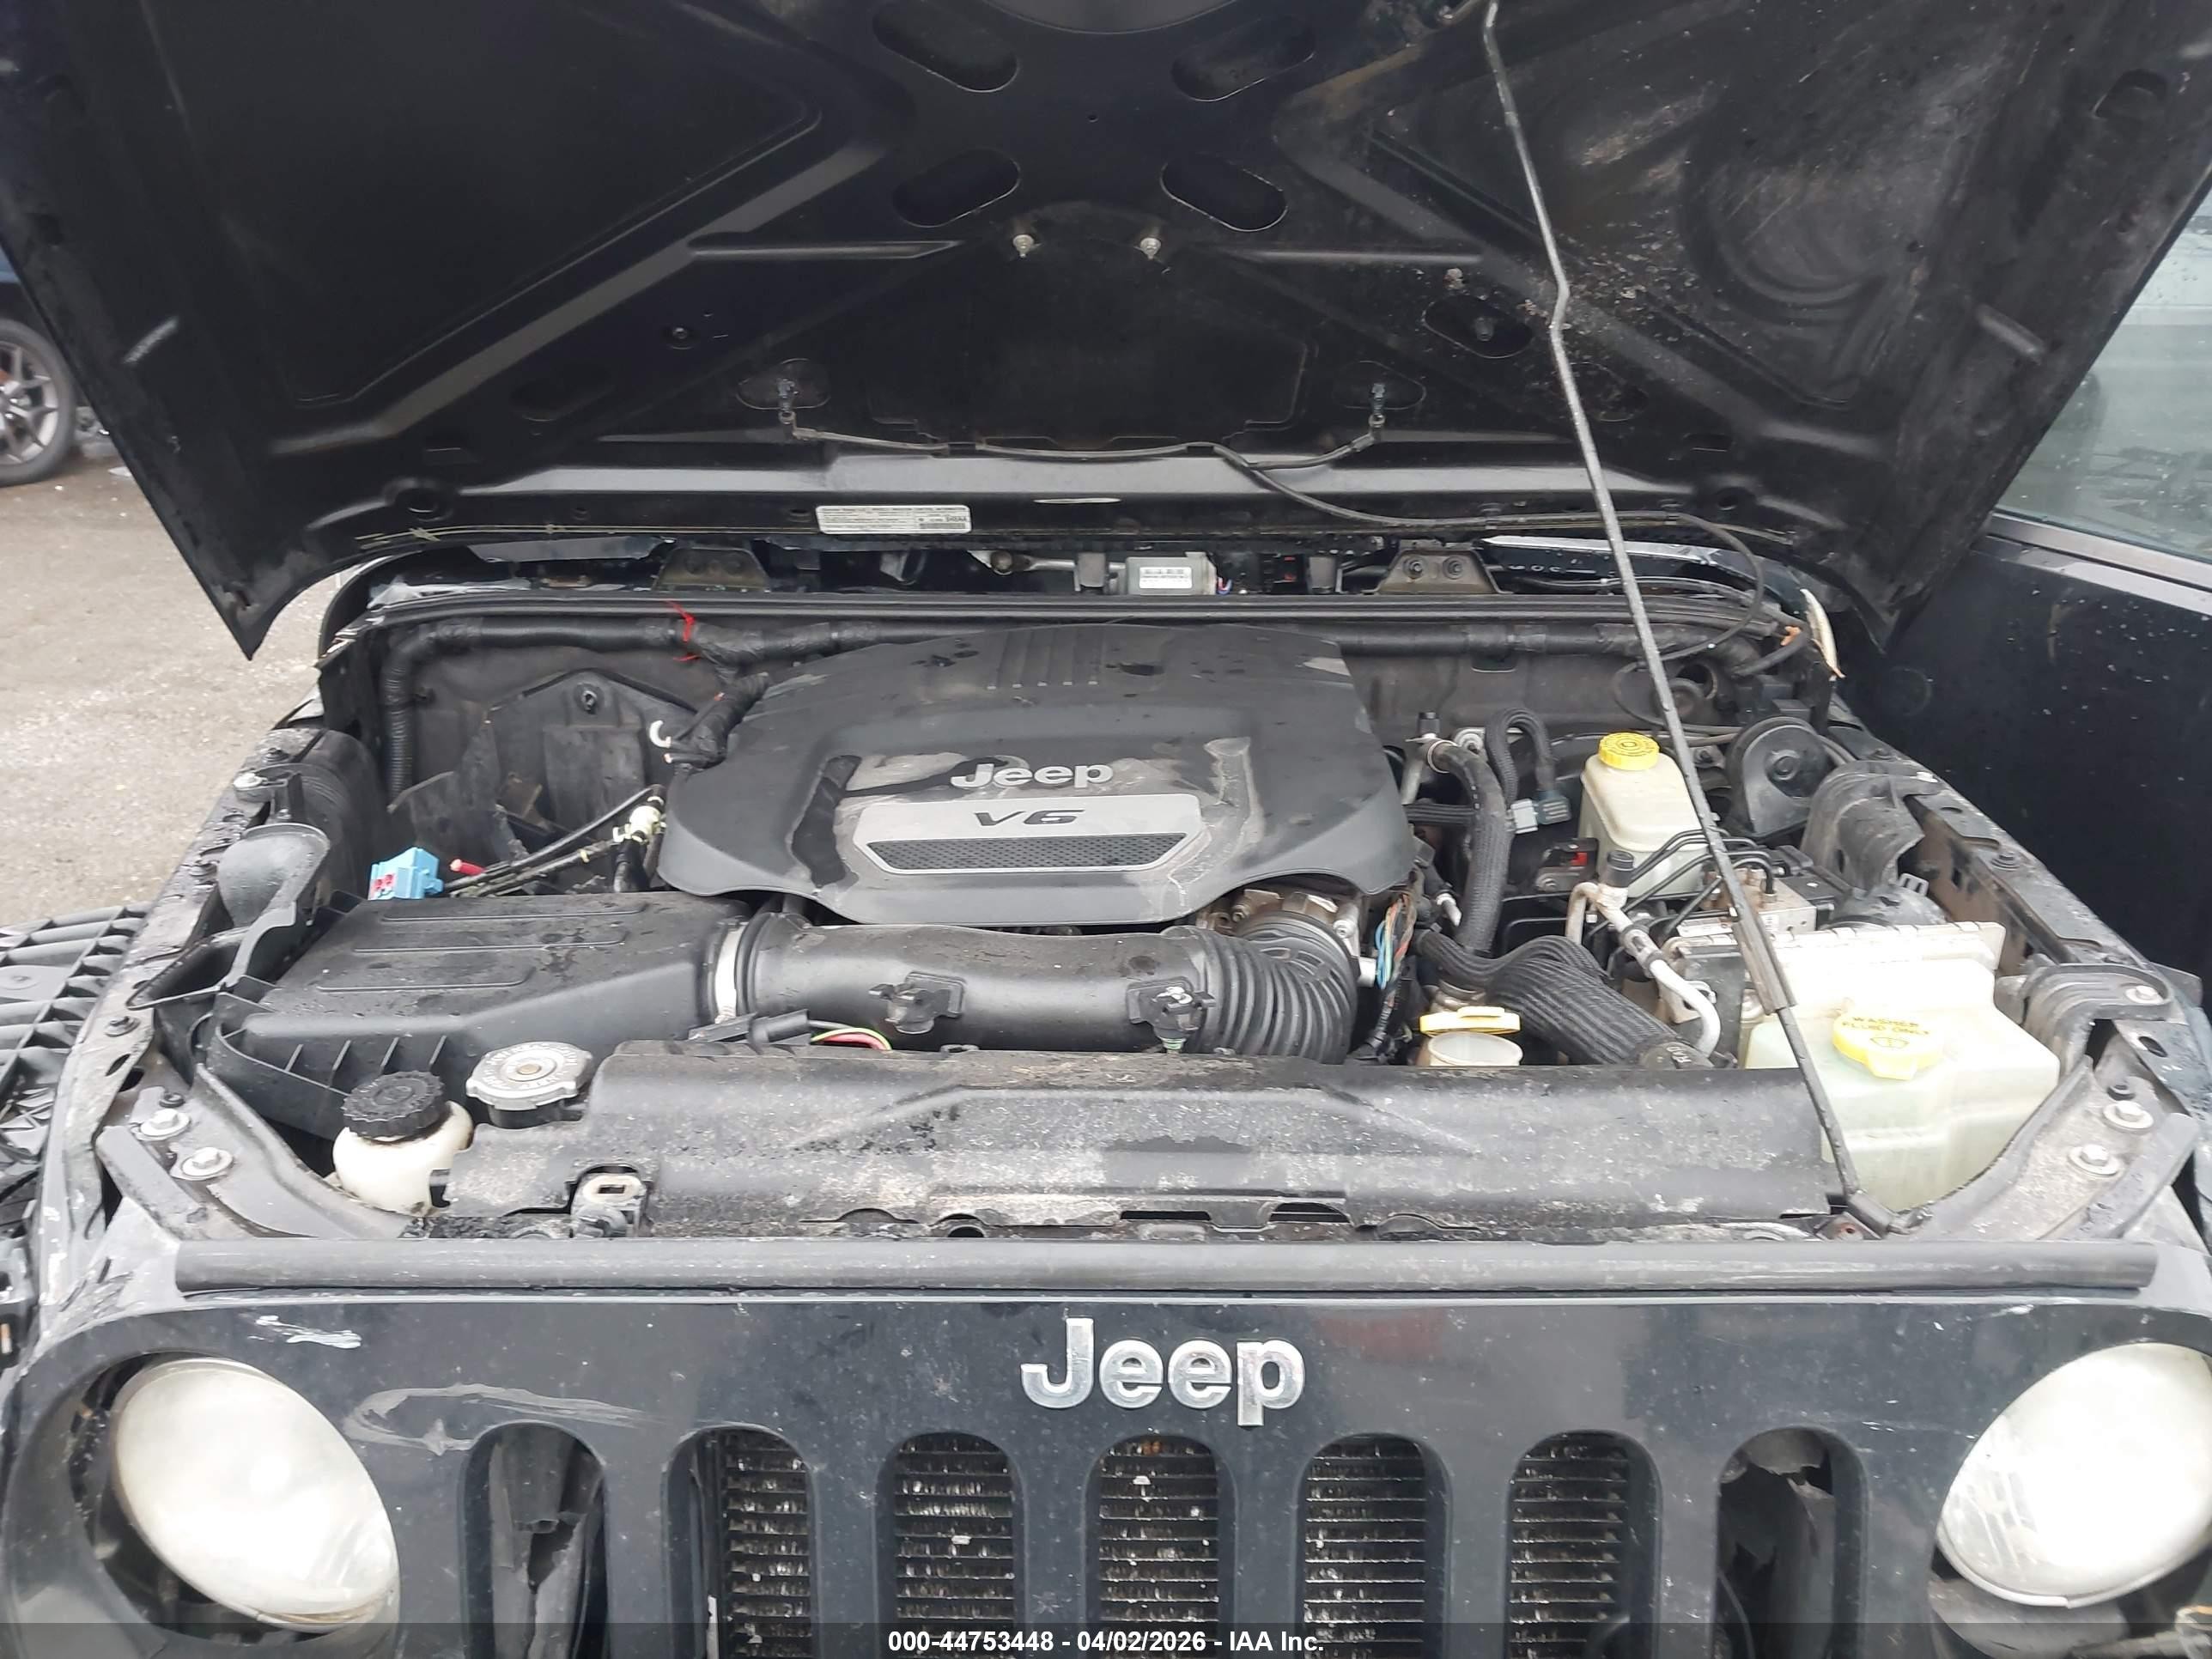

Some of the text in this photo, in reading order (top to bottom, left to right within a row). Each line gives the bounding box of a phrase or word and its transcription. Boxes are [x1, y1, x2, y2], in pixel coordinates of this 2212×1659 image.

[951, 763, 1113, 787] Jeep
[975, 810, 1085, 826] V6
[1020, 1317, 1305, 1426] Jeep
